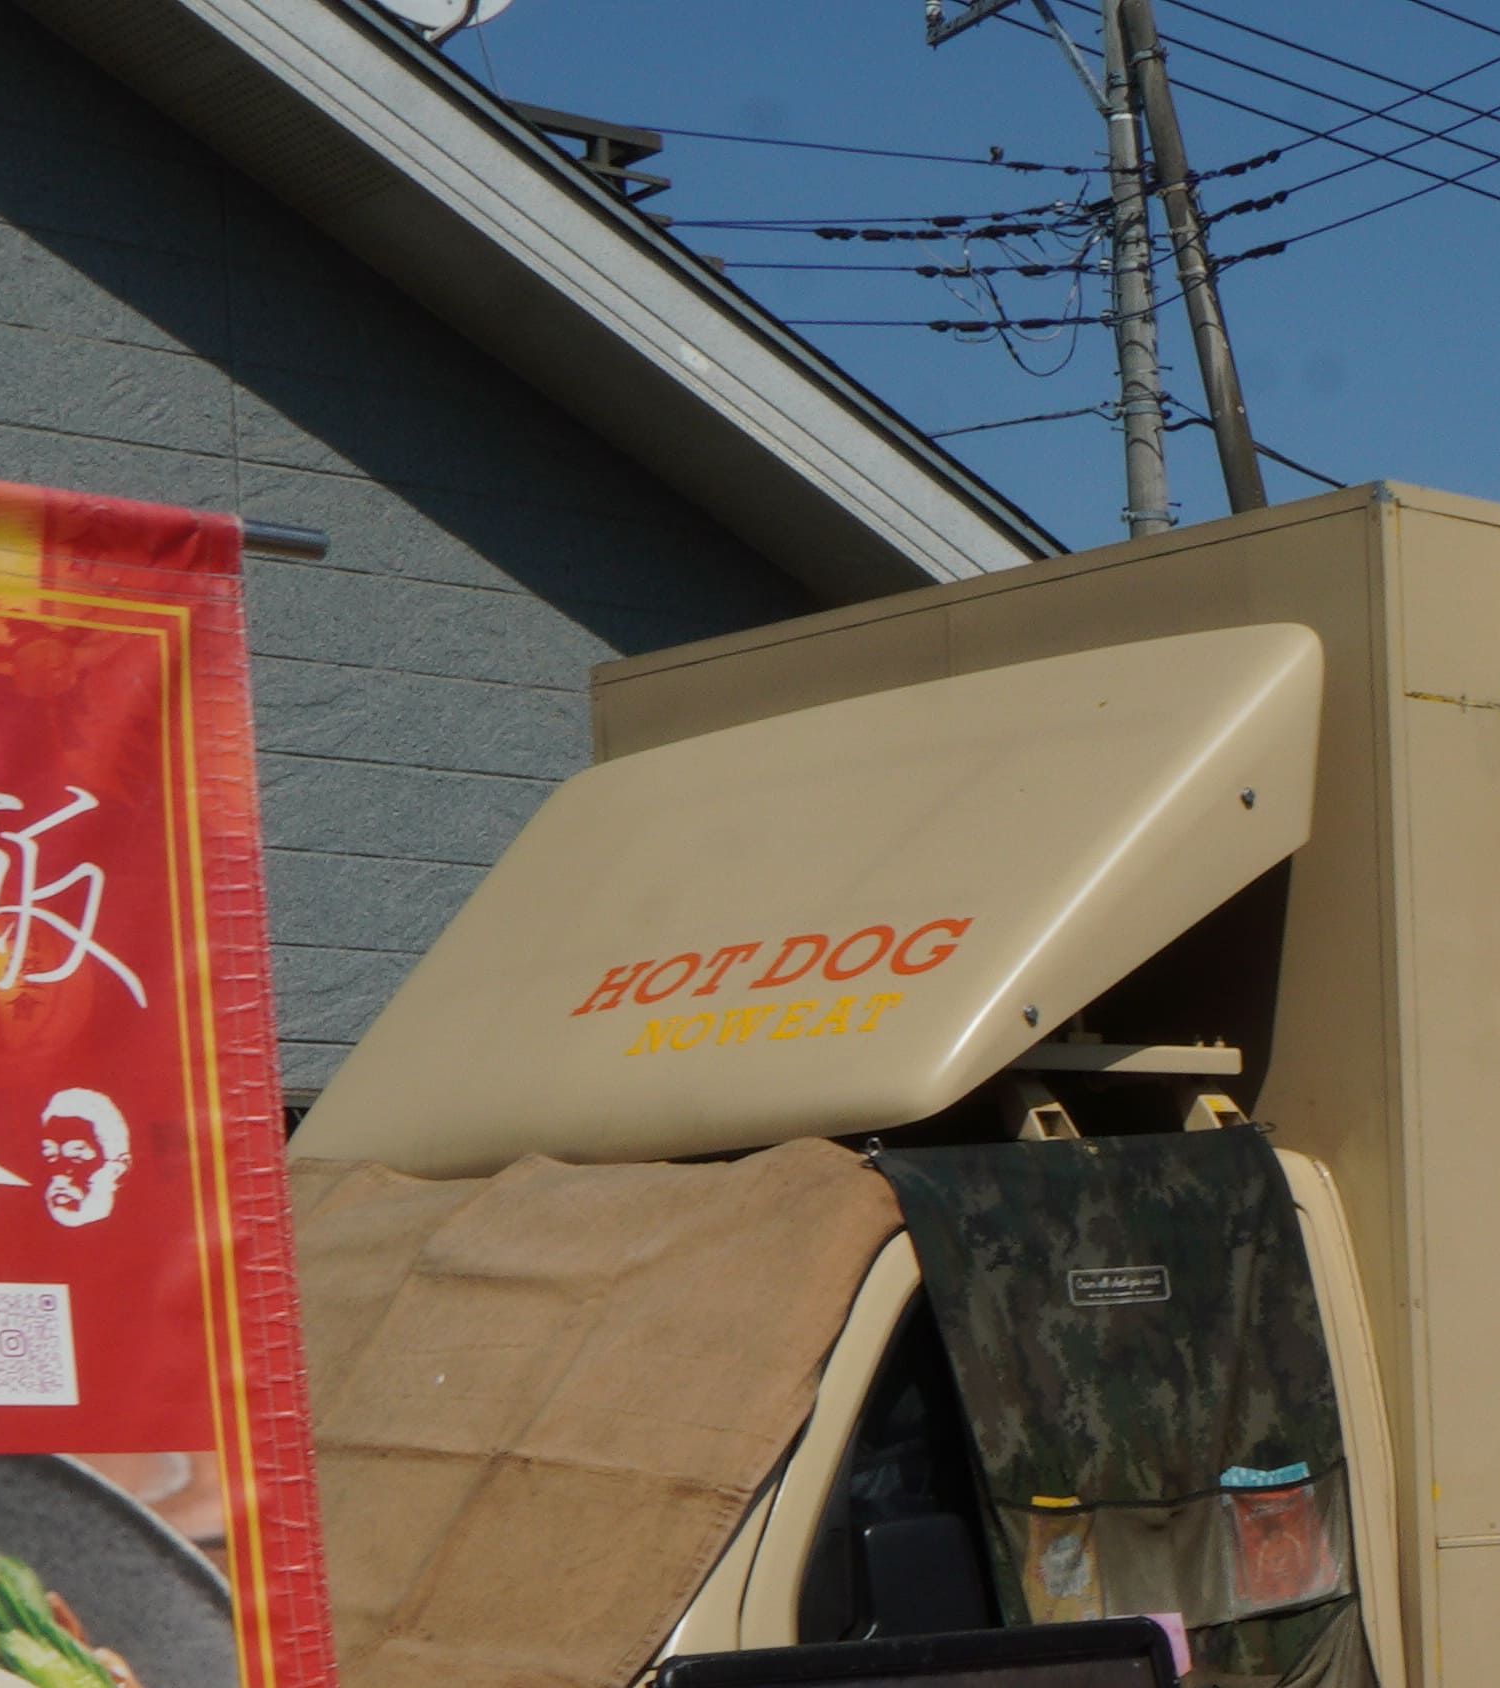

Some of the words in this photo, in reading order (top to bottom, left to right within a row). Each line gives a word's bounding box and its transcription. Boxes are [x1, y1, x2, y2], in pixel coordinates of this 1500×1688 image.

[568, 941, 764, 1017] HOT
[748, 917, 976, 990] DOG
[624, 992, 904, 1056] NOWEAT
